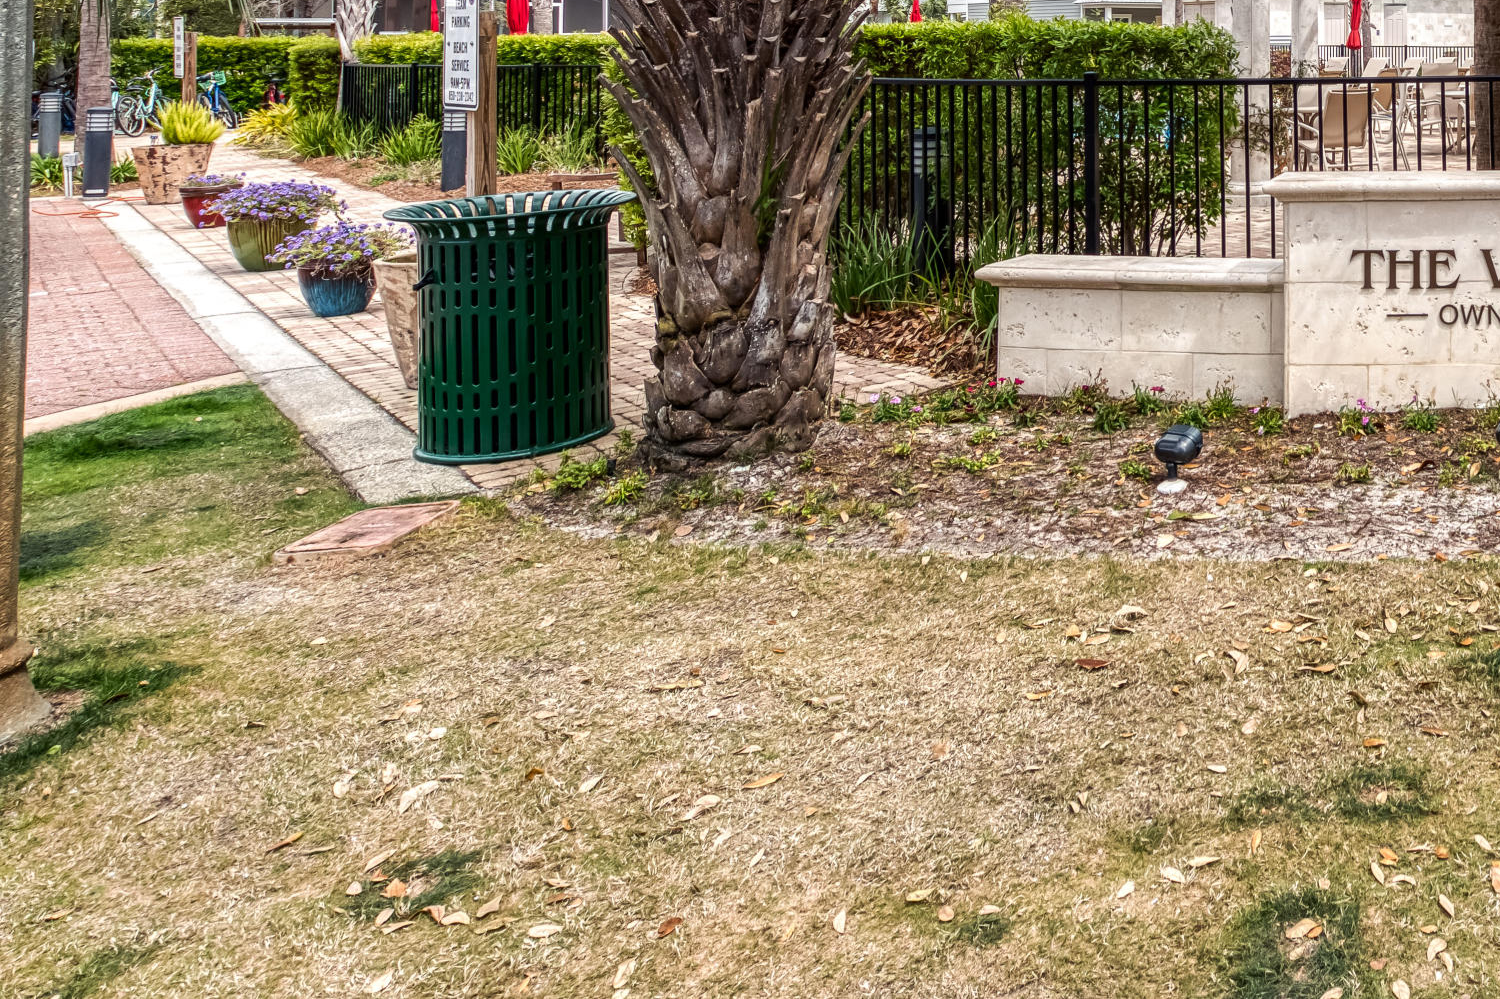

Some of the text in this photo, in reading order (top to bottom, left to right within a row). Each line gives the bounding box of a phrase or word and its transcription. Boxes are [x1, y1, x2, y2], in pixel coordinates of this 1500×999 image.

[451, 16, 470, 28] PARKING
[453, 41, 468, 54] BEACH
[451, 59, 470, 72] SERVICE
[1350, 248, 1461, 290] THE
